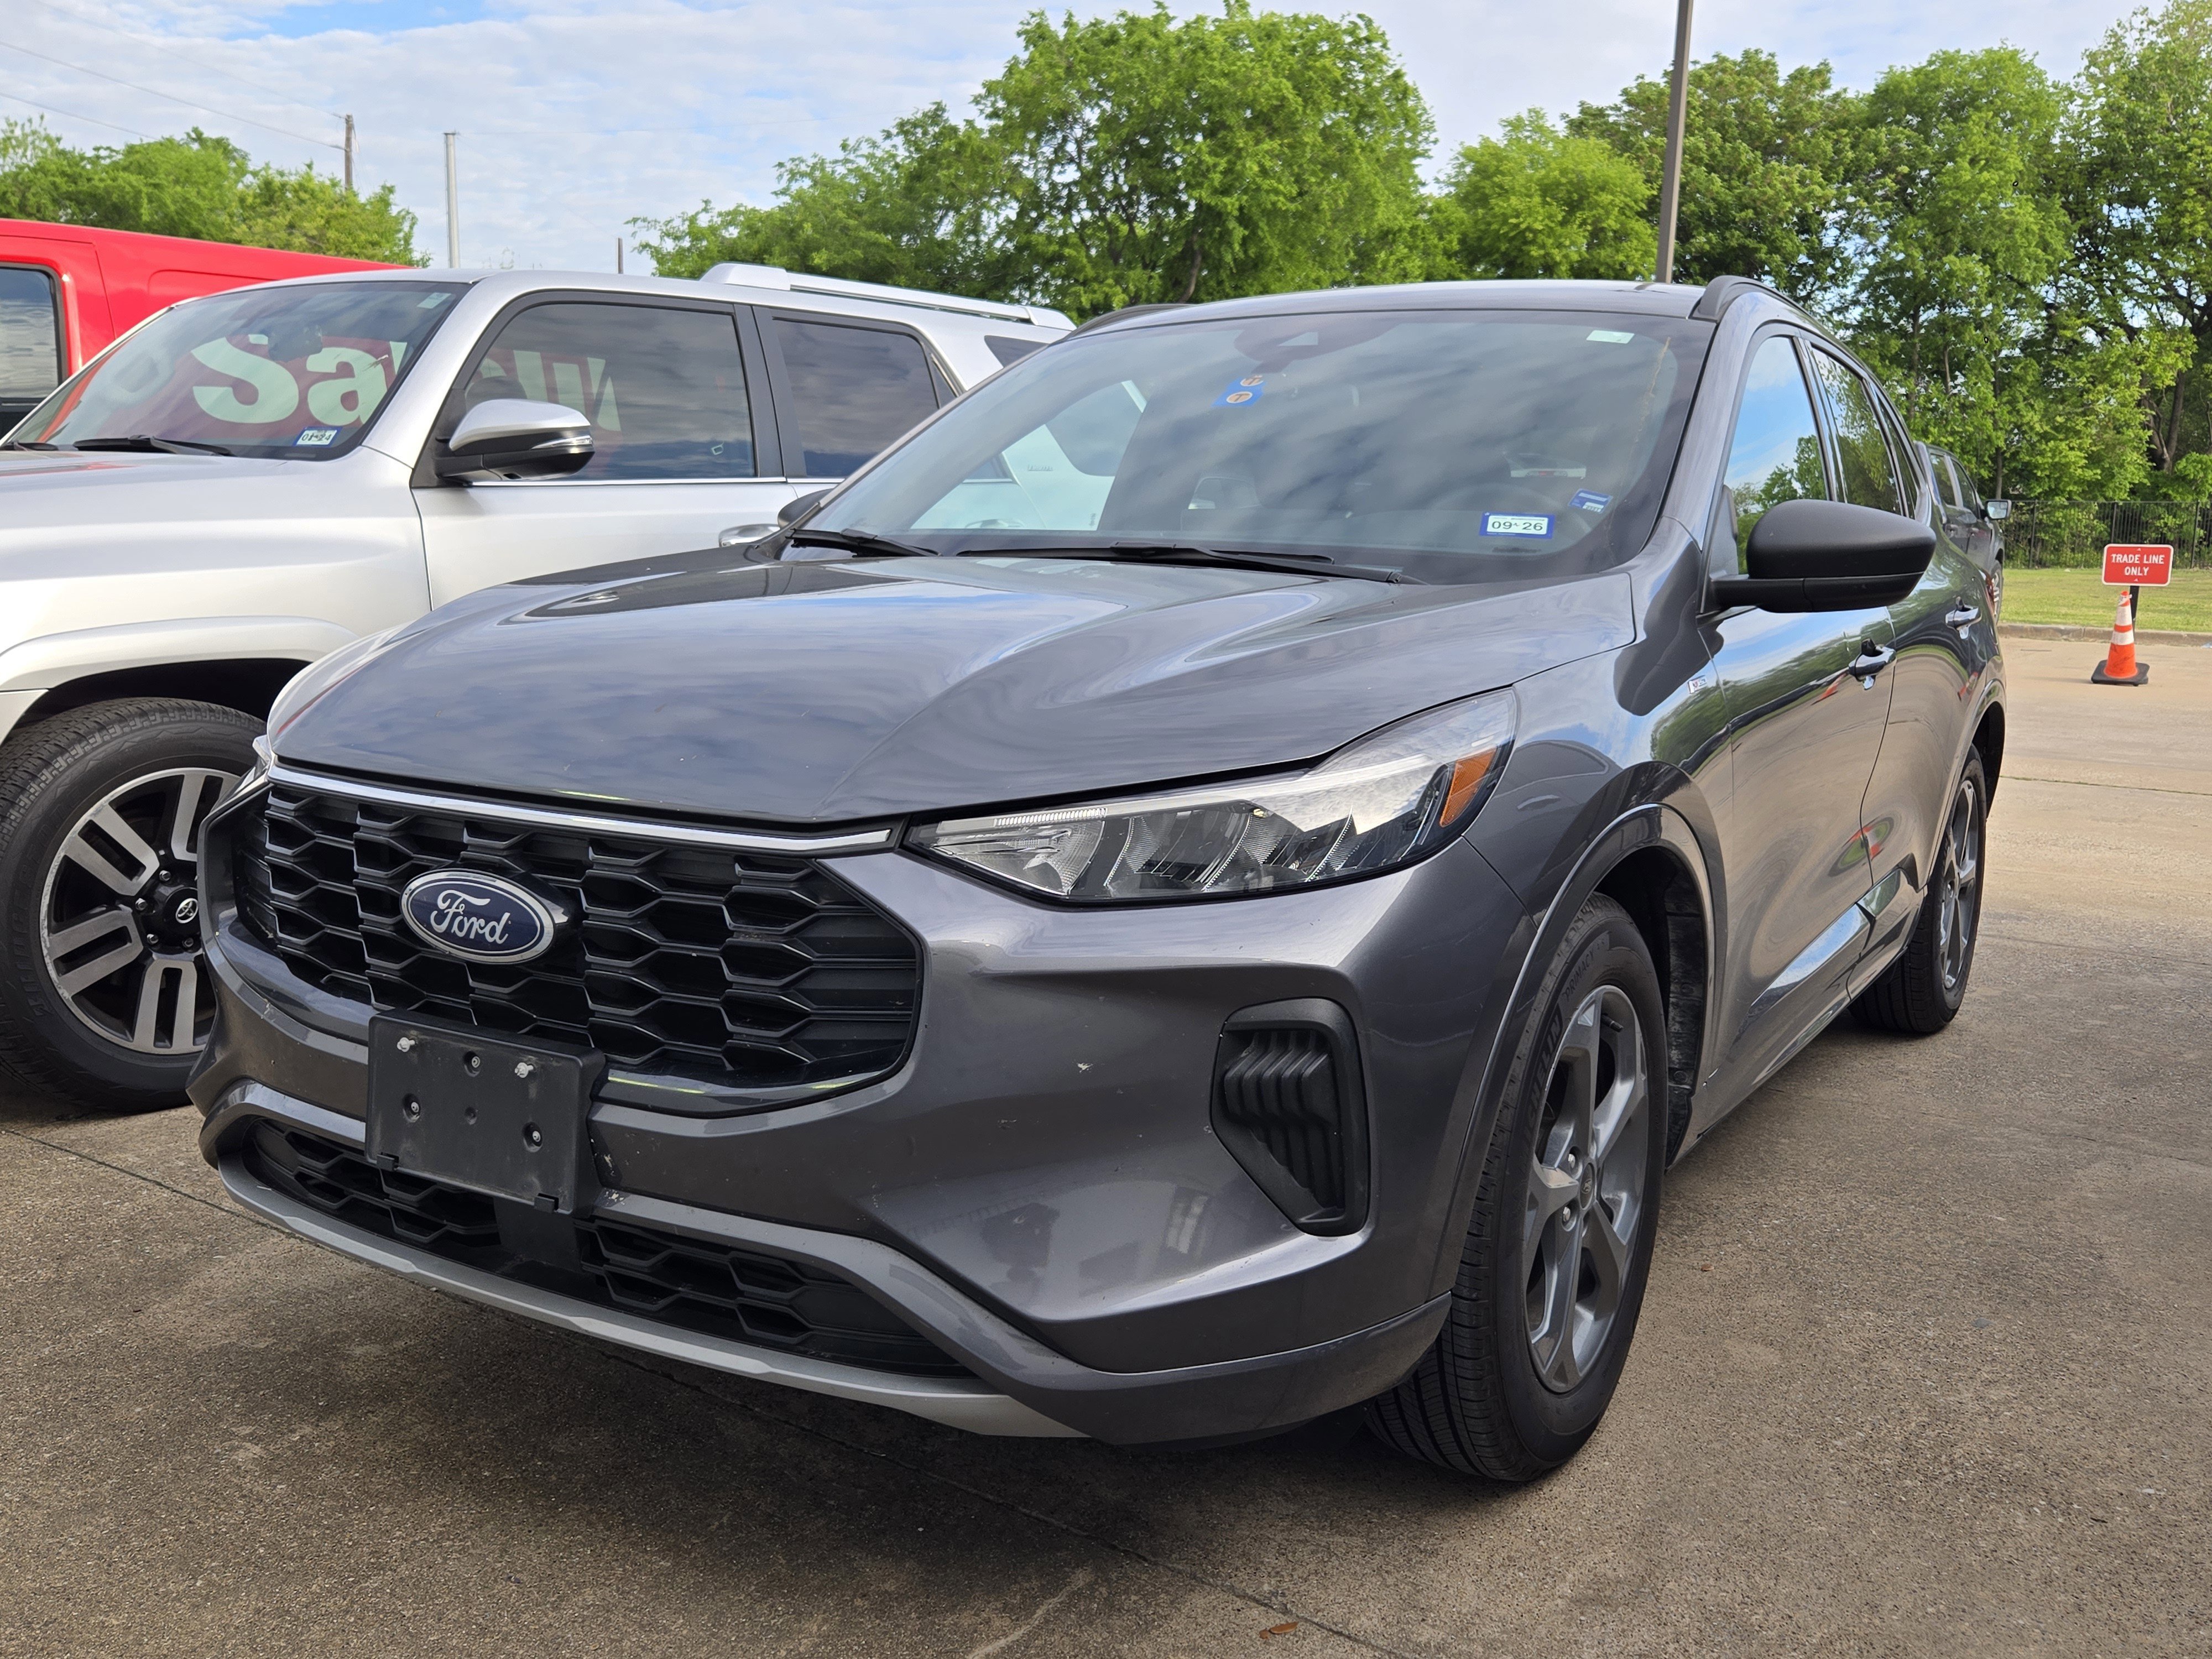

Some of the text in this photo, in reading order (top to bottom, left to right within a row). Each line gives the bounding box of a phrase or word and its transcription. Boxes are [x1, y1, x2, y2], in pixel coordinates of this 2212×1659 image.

[2110, 554, 2165, 564] TRADE LINE
[2124, 566, 2150, 576] ONLY
[430, 889, 511, 945] Ford
[1562, 950, 1594, 1001] PRIMACY
